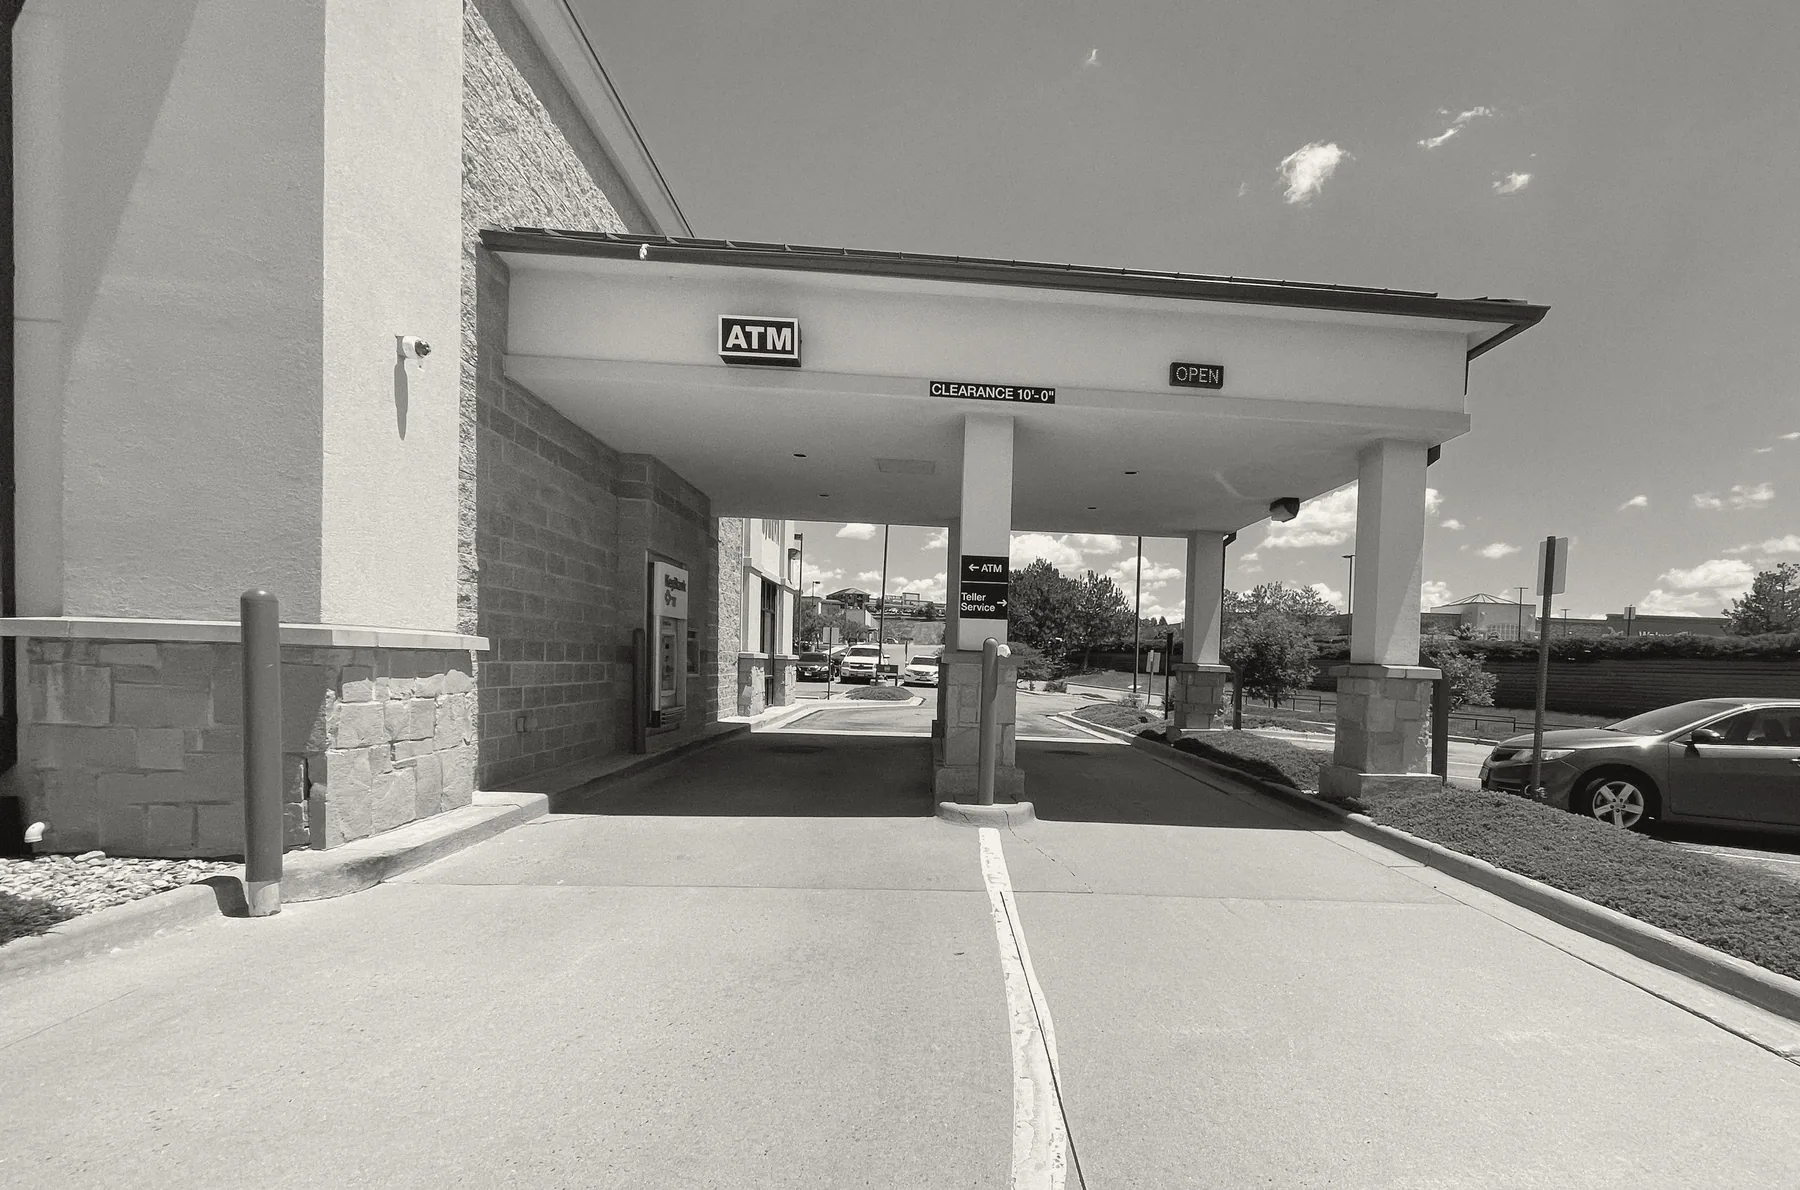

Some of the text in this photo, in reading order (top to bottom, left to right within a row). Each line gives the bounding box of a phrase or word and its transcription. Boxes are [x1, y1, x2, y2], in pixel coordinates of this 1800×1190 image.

[725, 324, 792, 351] ATM
[1176, 366, 1219, 384] OPEN
[931, 383, 1014, 400] CLEARANCE
[980, 563, 1003, 573] ATM
[961, 592, 987, 602] Teller
[960, 602, 996, 612] Service
